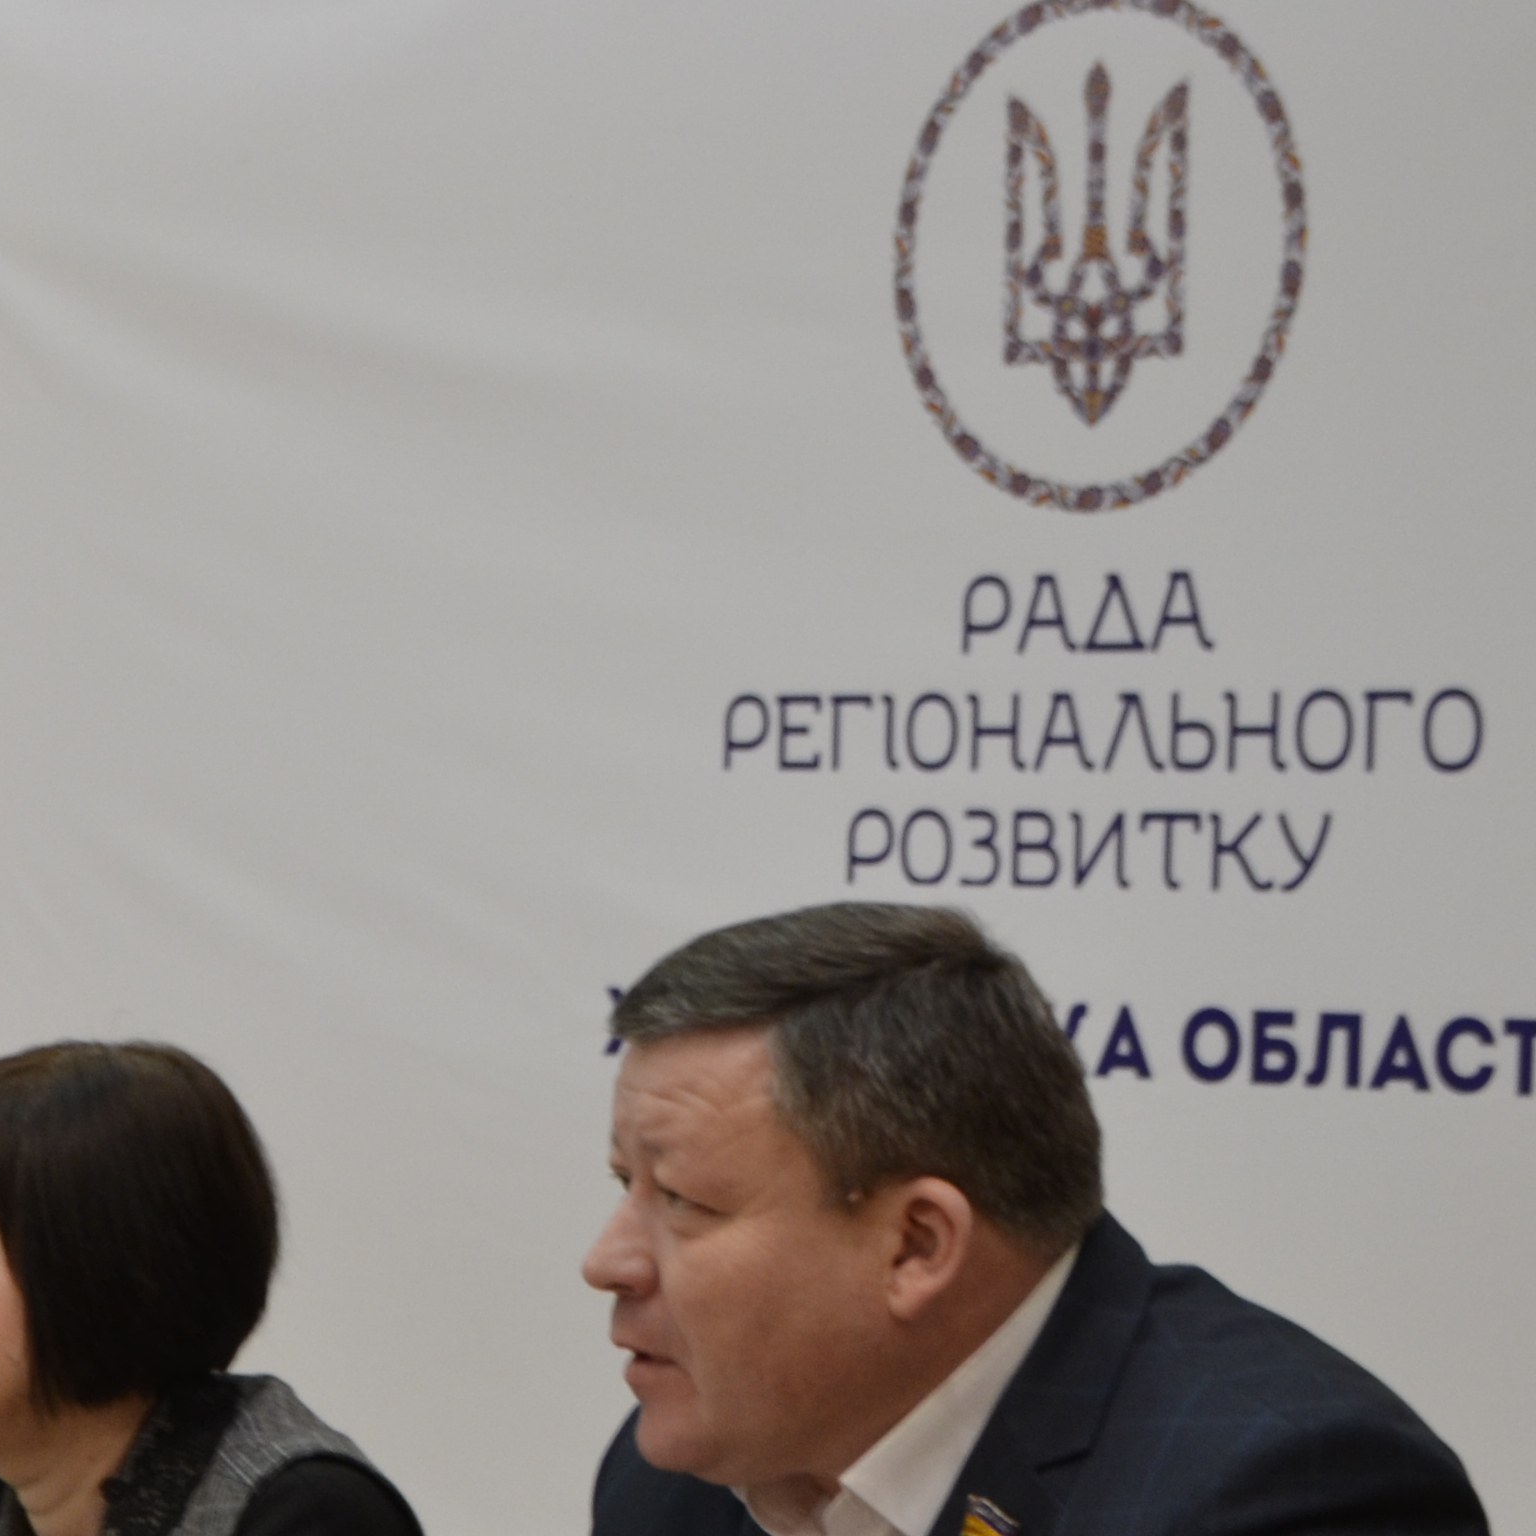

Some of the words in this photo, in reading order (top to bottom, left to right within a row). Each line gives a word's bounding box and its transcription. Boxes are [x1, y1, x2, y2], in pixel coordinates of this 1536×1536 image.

[961, 570, 1214, 654] РАДА
[723, 688, 1485, 774] РЕГІОНАЛЬНОГО
[845, 808, 1333, 892] РОЗВИТКУ
